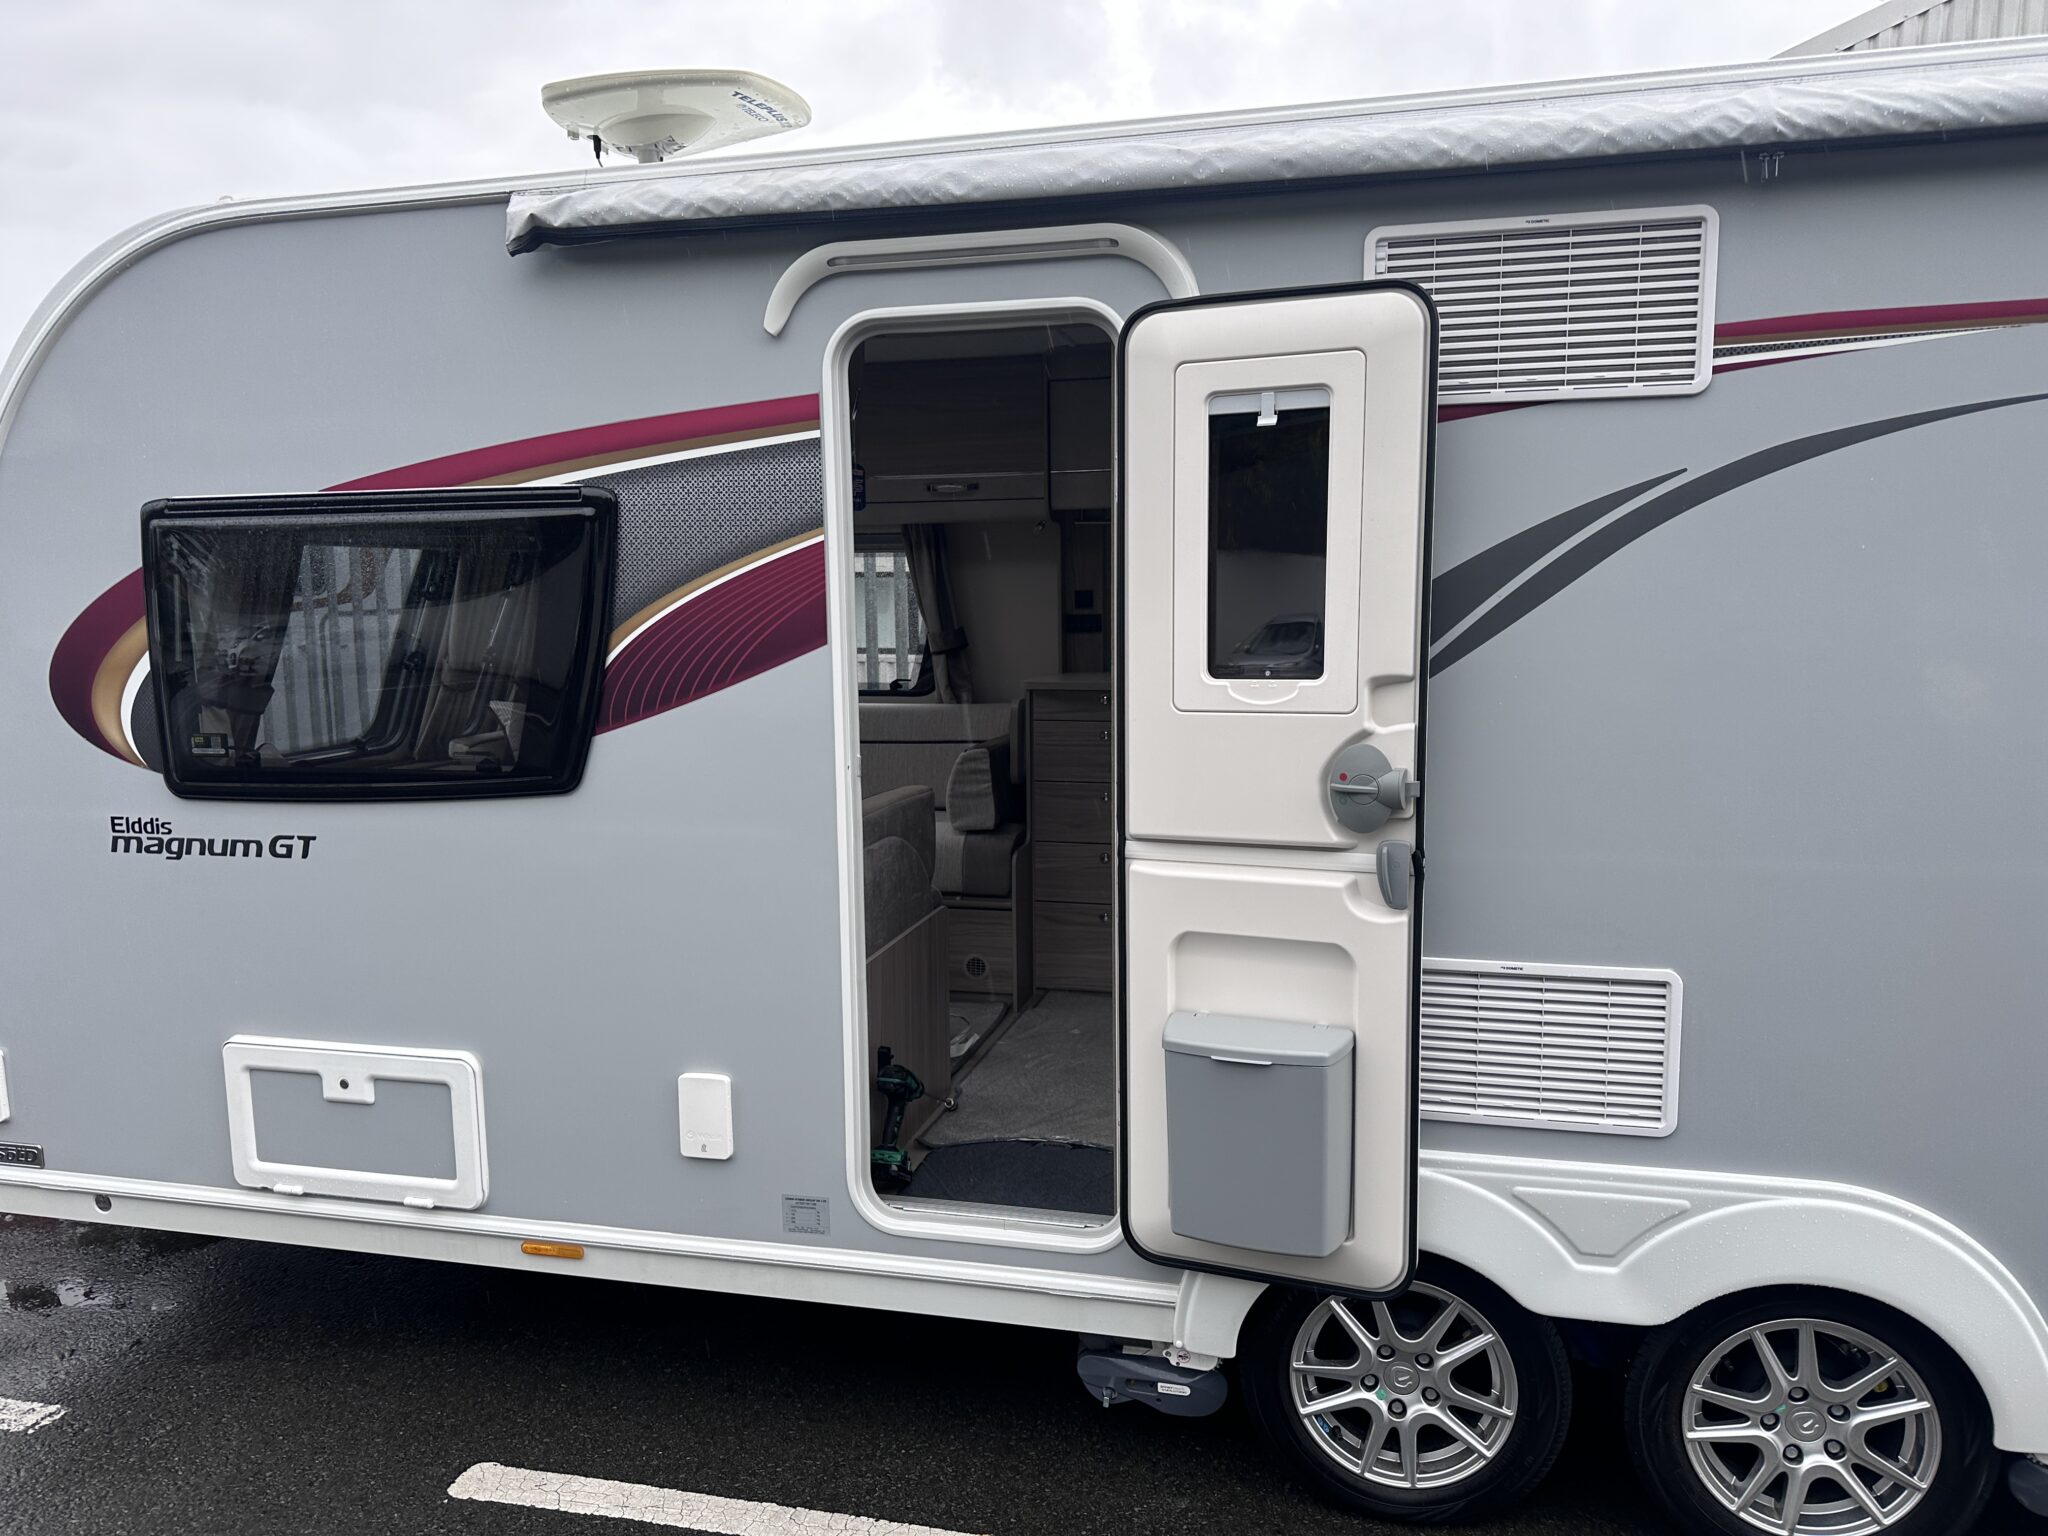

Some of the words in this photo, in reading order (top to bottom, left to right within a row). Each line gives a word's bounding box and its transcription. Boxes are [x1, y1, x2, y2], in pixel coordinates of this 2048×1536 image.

[731, 90, 788, 123] TELEPLUS
[110, 816, 172, 835] Elddis
[110, 835, 263, 860] magnum
[268, 835, 317, 859] GT
